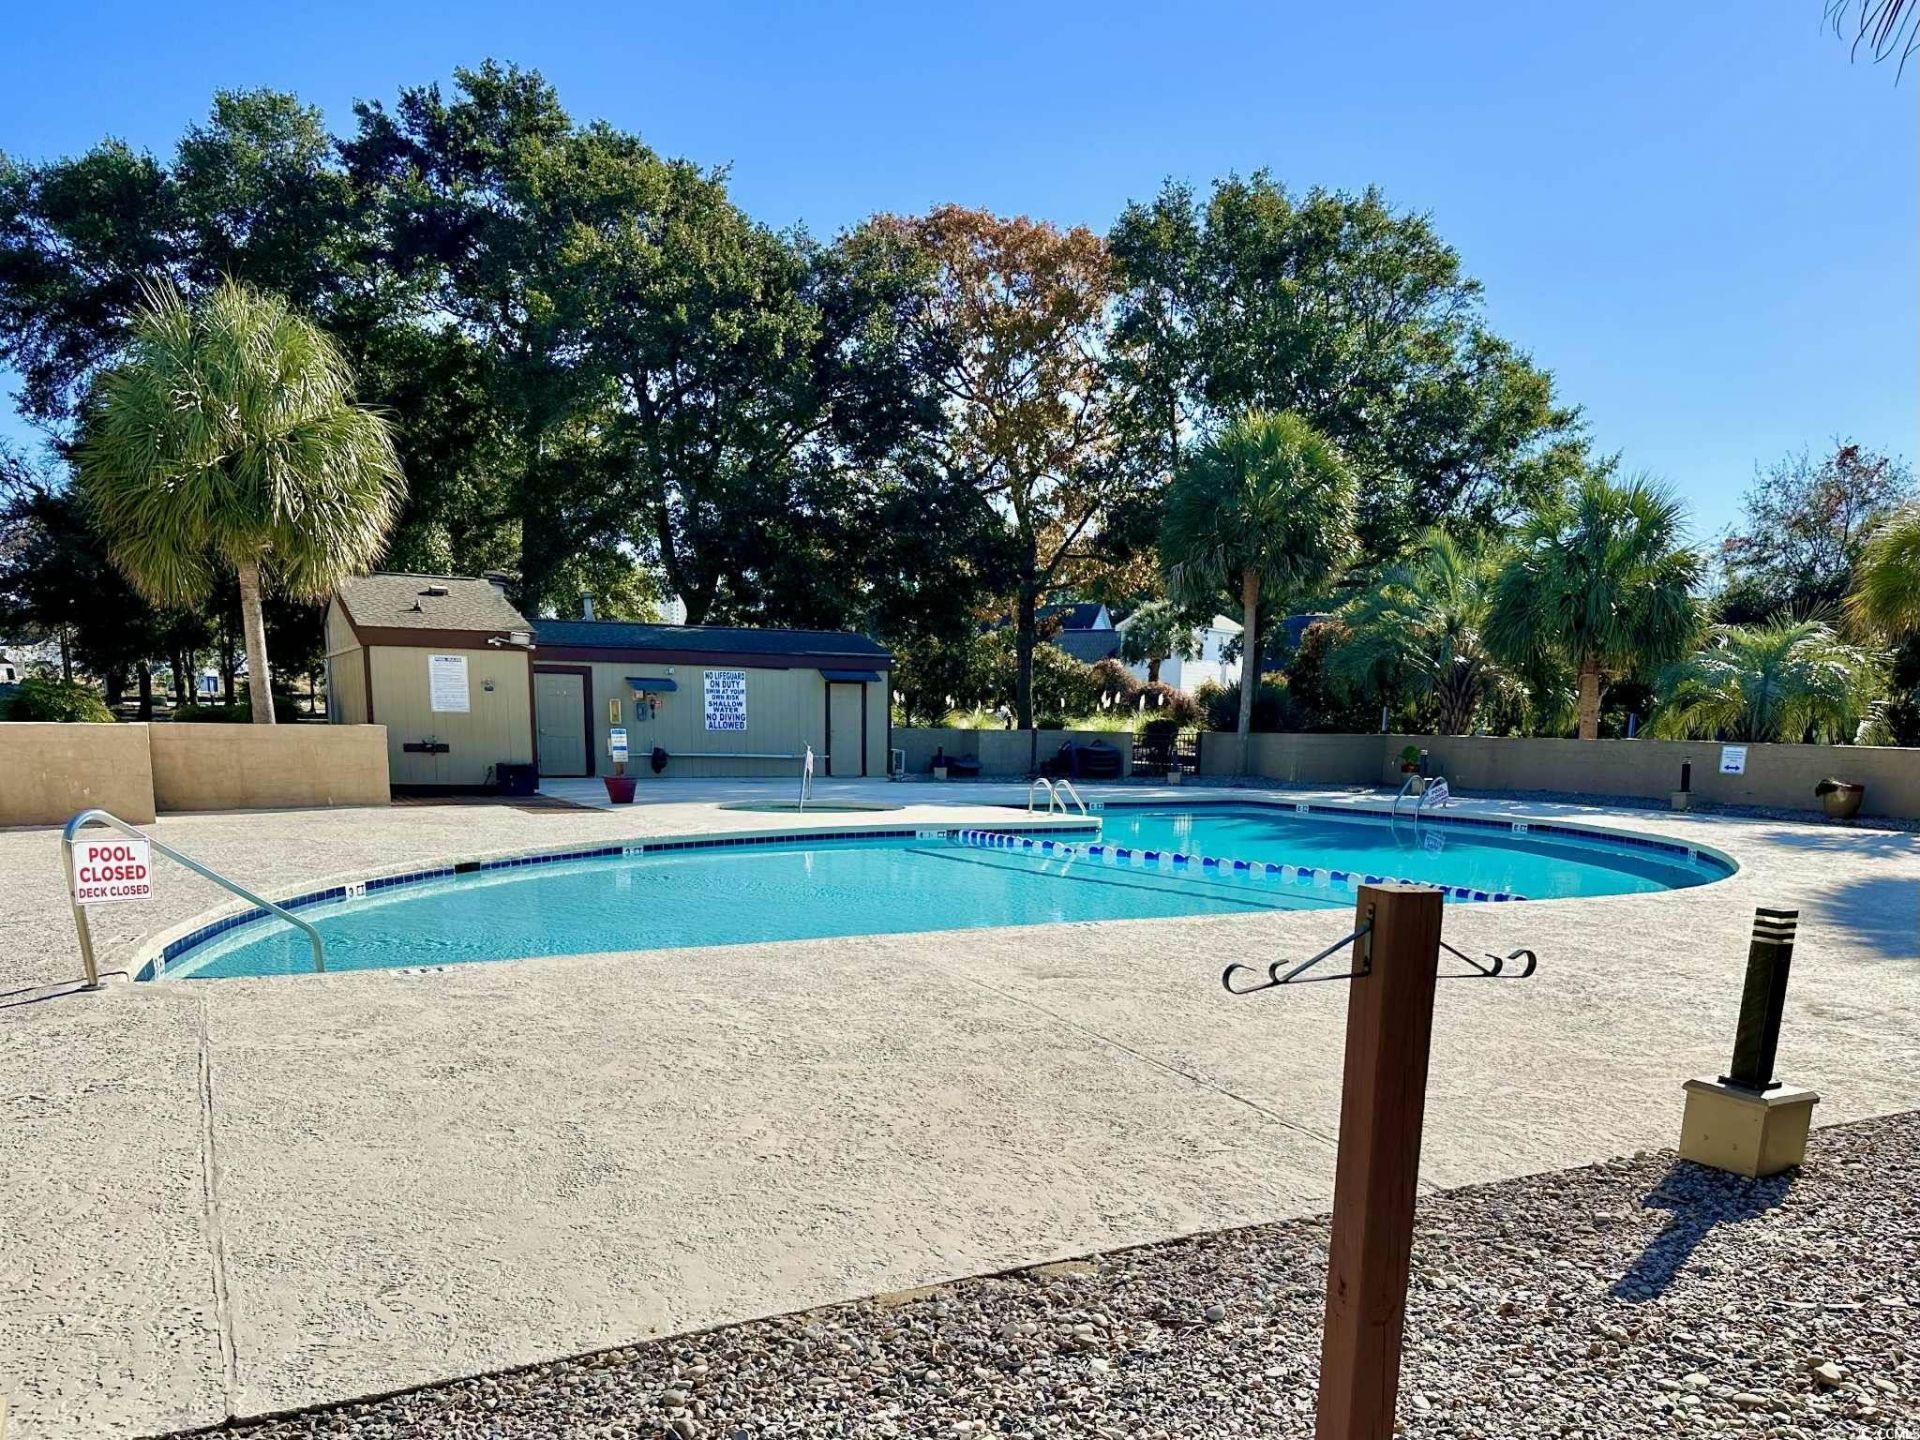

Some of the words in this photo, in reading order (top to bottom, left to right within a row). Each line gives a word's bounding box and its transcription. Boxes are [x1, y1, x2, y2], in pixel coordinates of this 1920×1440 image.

[705, 672, 713, 680] NO
[715, 672, 744, 680] LIFEGUARD
[89, 846, 136, 862] POOL
[80, 865, 146, 882] CLOSED
[79, 886, 108, 898] DECK
[110, 885, 149, 897] CLOSED
